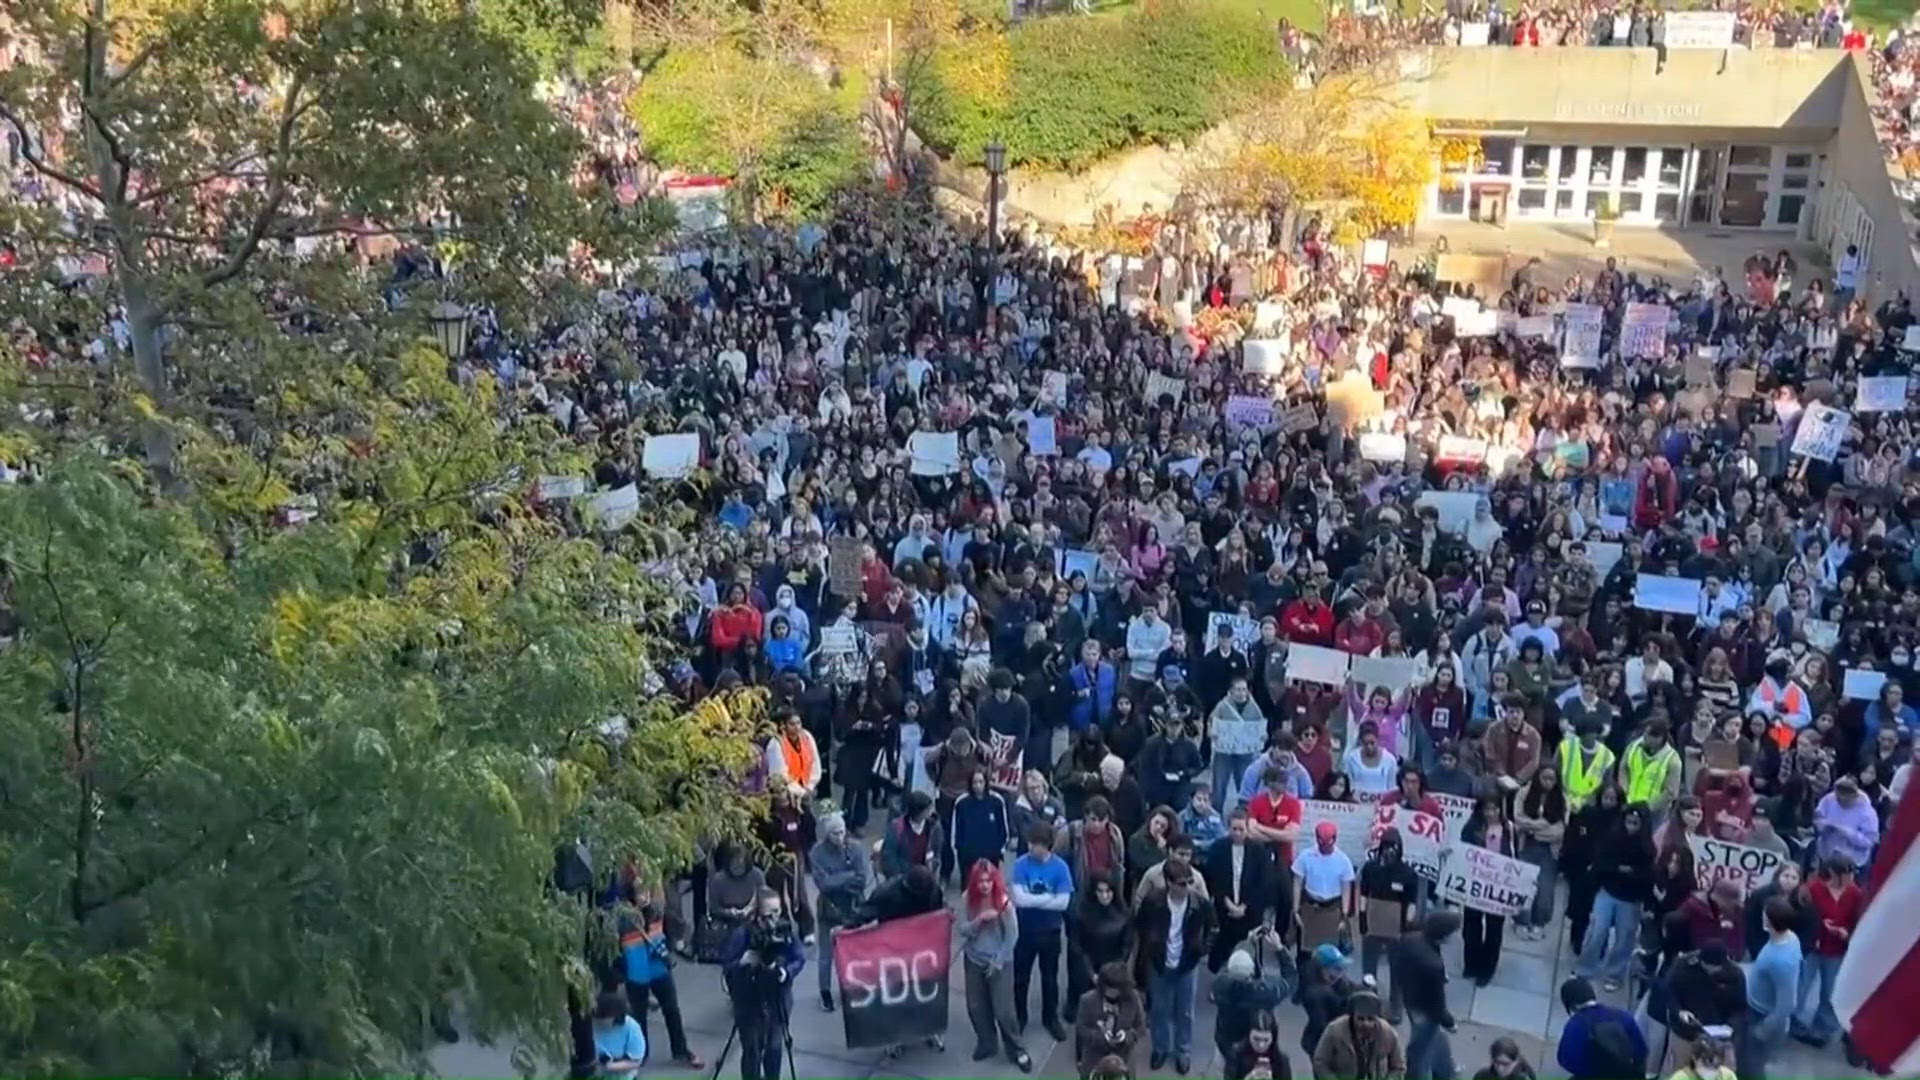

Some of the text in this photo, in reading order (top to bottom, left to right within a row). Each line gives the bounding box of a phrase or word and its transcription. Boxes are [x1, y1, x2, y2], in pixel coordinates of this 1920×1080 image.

[1700, 840, 1778, 875] STOP
[1445, 872, 1467, 895] 1.2
[844, 949, 939, 1008] SDC
